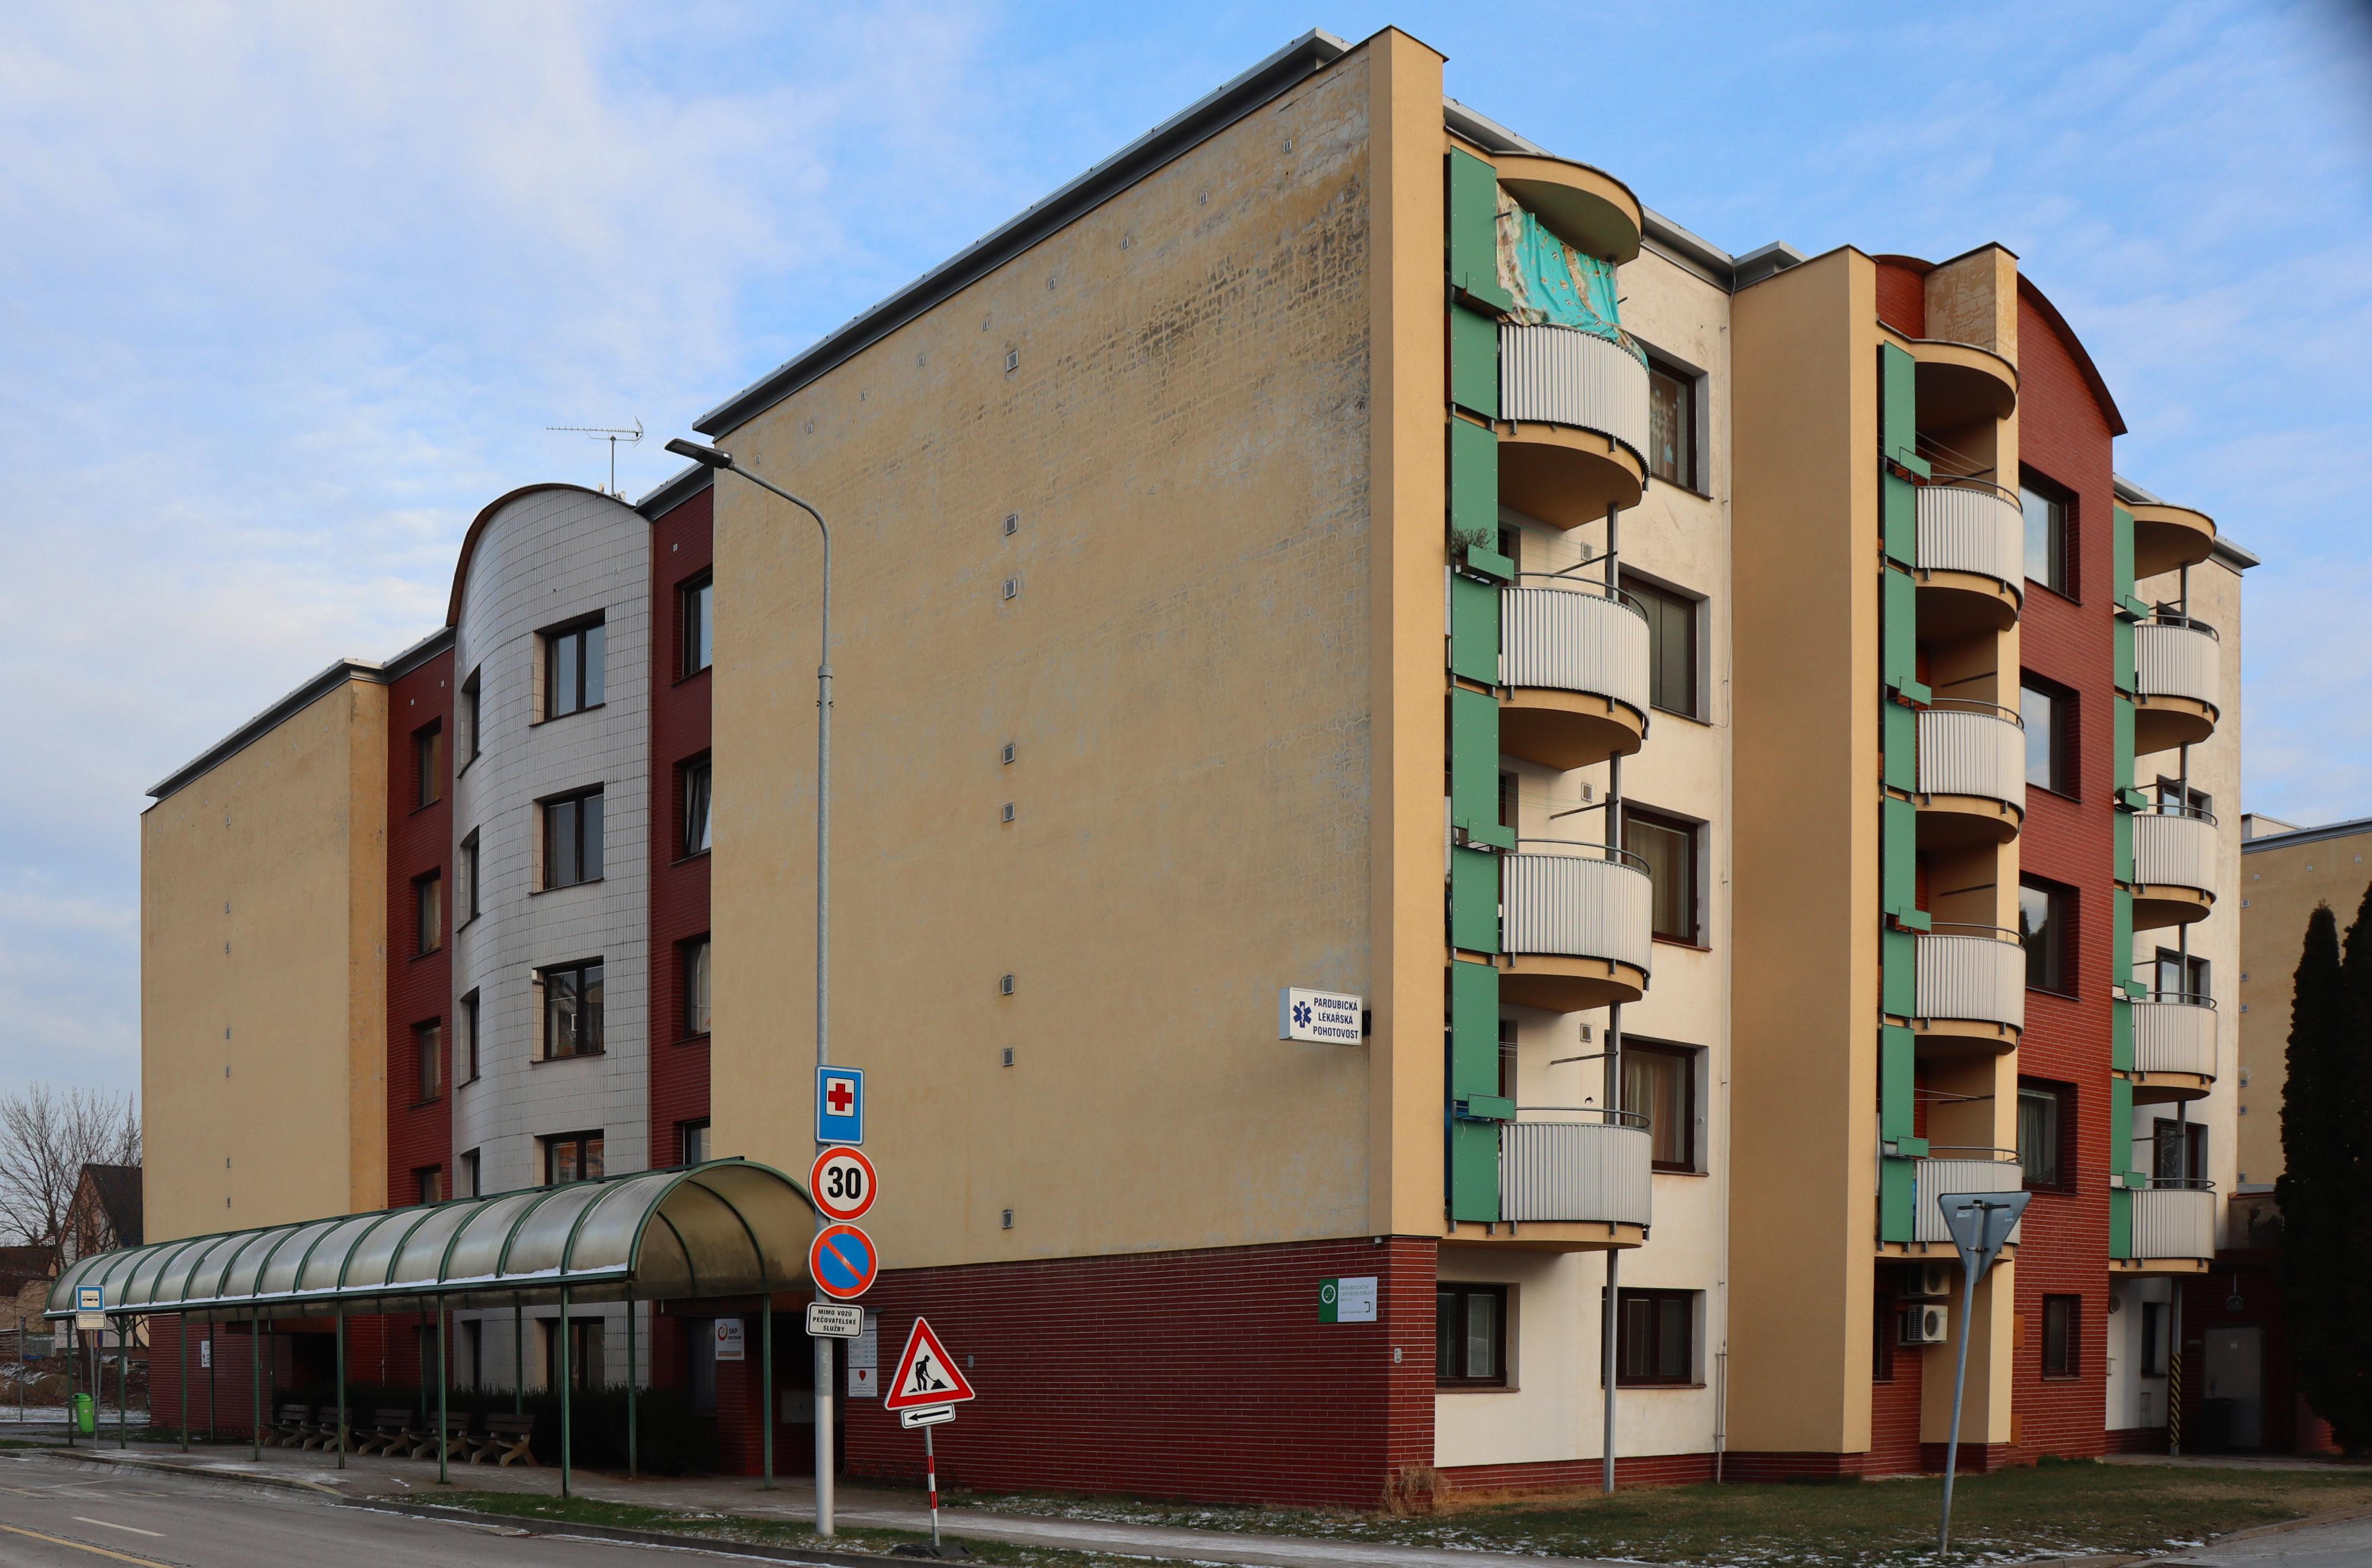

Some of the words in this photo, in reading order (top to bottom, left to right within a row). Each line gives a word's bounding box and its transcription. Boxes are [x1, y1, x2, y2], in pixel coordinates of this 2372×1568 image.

[1314, 998, 1357, 1011] PARDUBICKÁ
[1318, 1011, 1353, 1024] LÉKAŘSKÁ
[1313, 1026, 1359, 1039] POHOTOVOST
[828, 1166, 861, 1199] 30
[812, 1316, 856, 1325] PEČOVATELSKÉ
